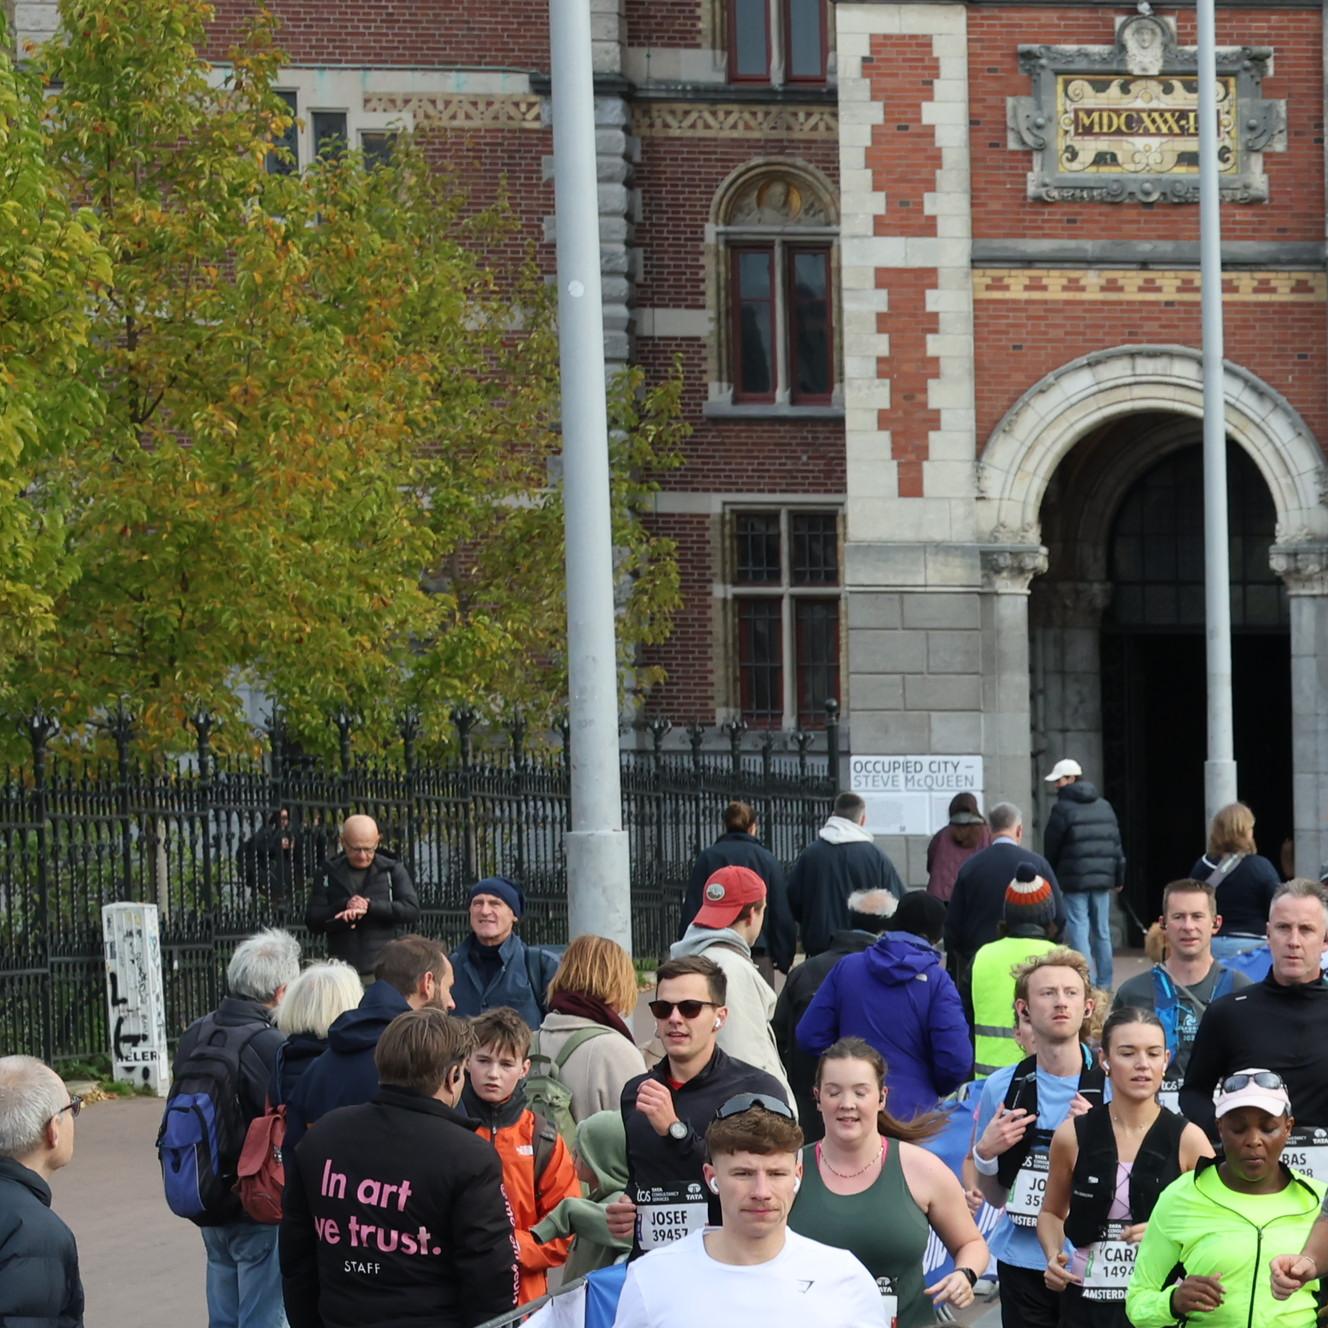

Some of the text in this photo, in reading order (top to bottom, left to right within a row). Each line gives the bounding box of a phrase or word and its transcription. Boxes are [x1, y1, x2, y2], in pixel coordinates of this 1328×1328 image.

[853, 760, 961, 774] OCCUPIED CITY
[854, 775, 975, 789] STEVE McQUEEN
[1281, 1152, 1307, 1167] BAS
[321, 1159, 413, 1213] In art
[651, 1210, 688, 1226] JOSEF
[348, 1216, 442, 1256] trust.
[344, 1260, 381, 1275] STAFF
